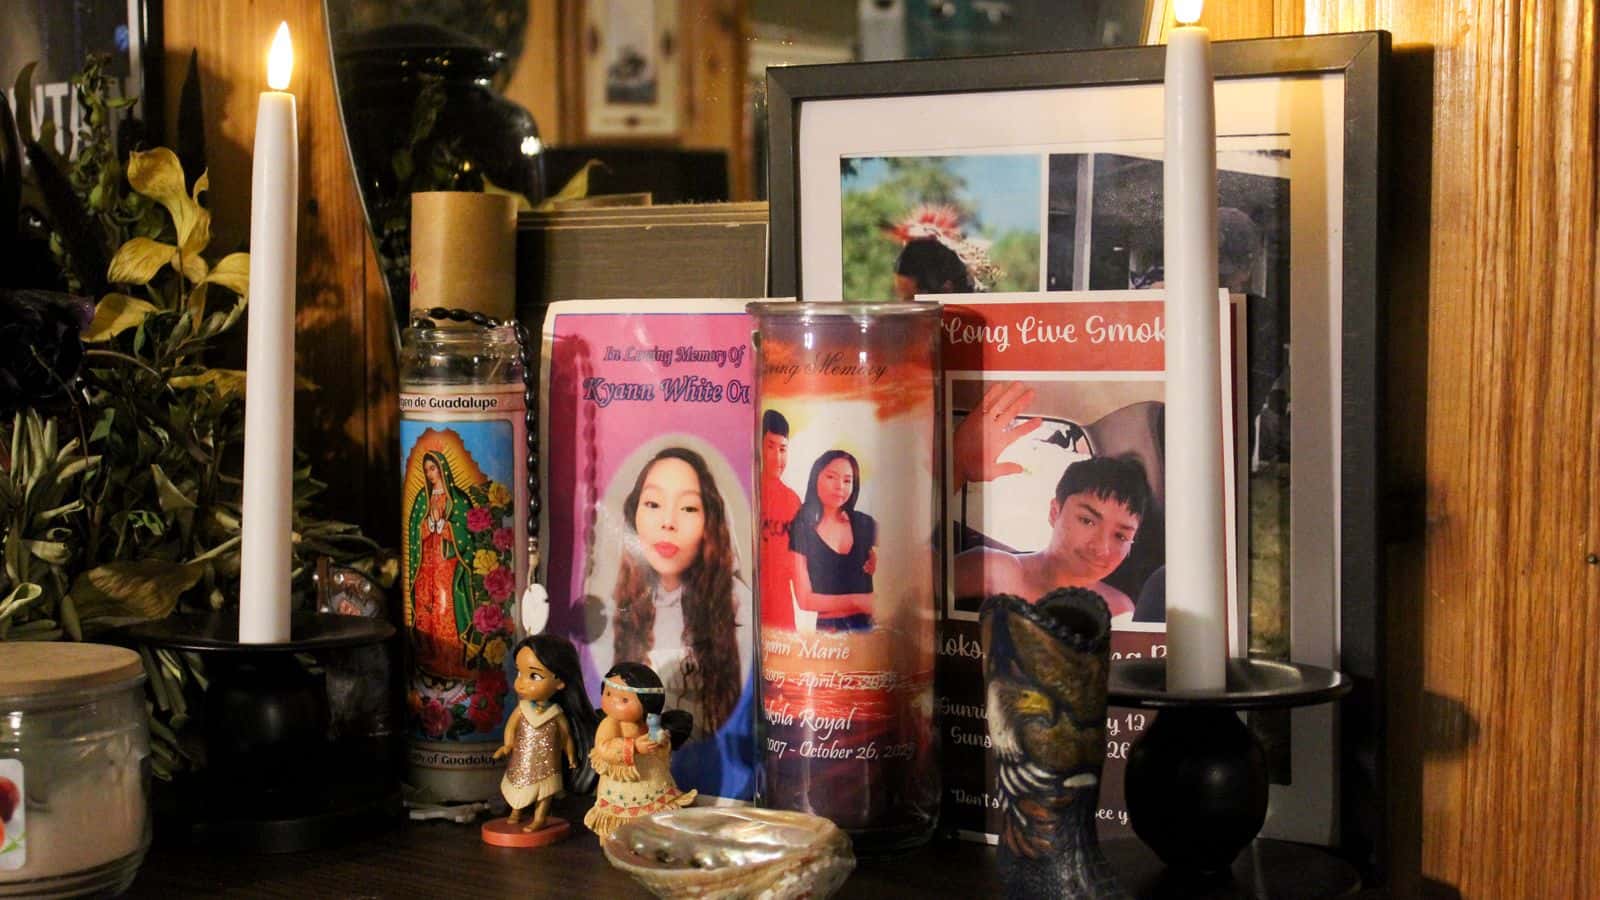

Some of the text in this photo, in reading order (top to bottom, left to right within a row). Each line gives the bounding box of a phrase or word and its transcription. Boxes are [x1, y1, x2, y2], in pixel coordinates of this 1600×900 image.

[1016, 315, 1078, 345] Live
[674, 344, 728, 368] Memory
[728, 344, 746, 368] Of
[414, 397, 427, 408] de
[429, 396, 498, 410] Guadalupe
[582, 376, 655, 408] Kyann
[661, 374, 723, 403] White
[797, 638, 849, 660] Marie
[799, 705, 857, 741] Royal
[799, 739, 853, 759] October
[855, 742, 880, 760] 26,
